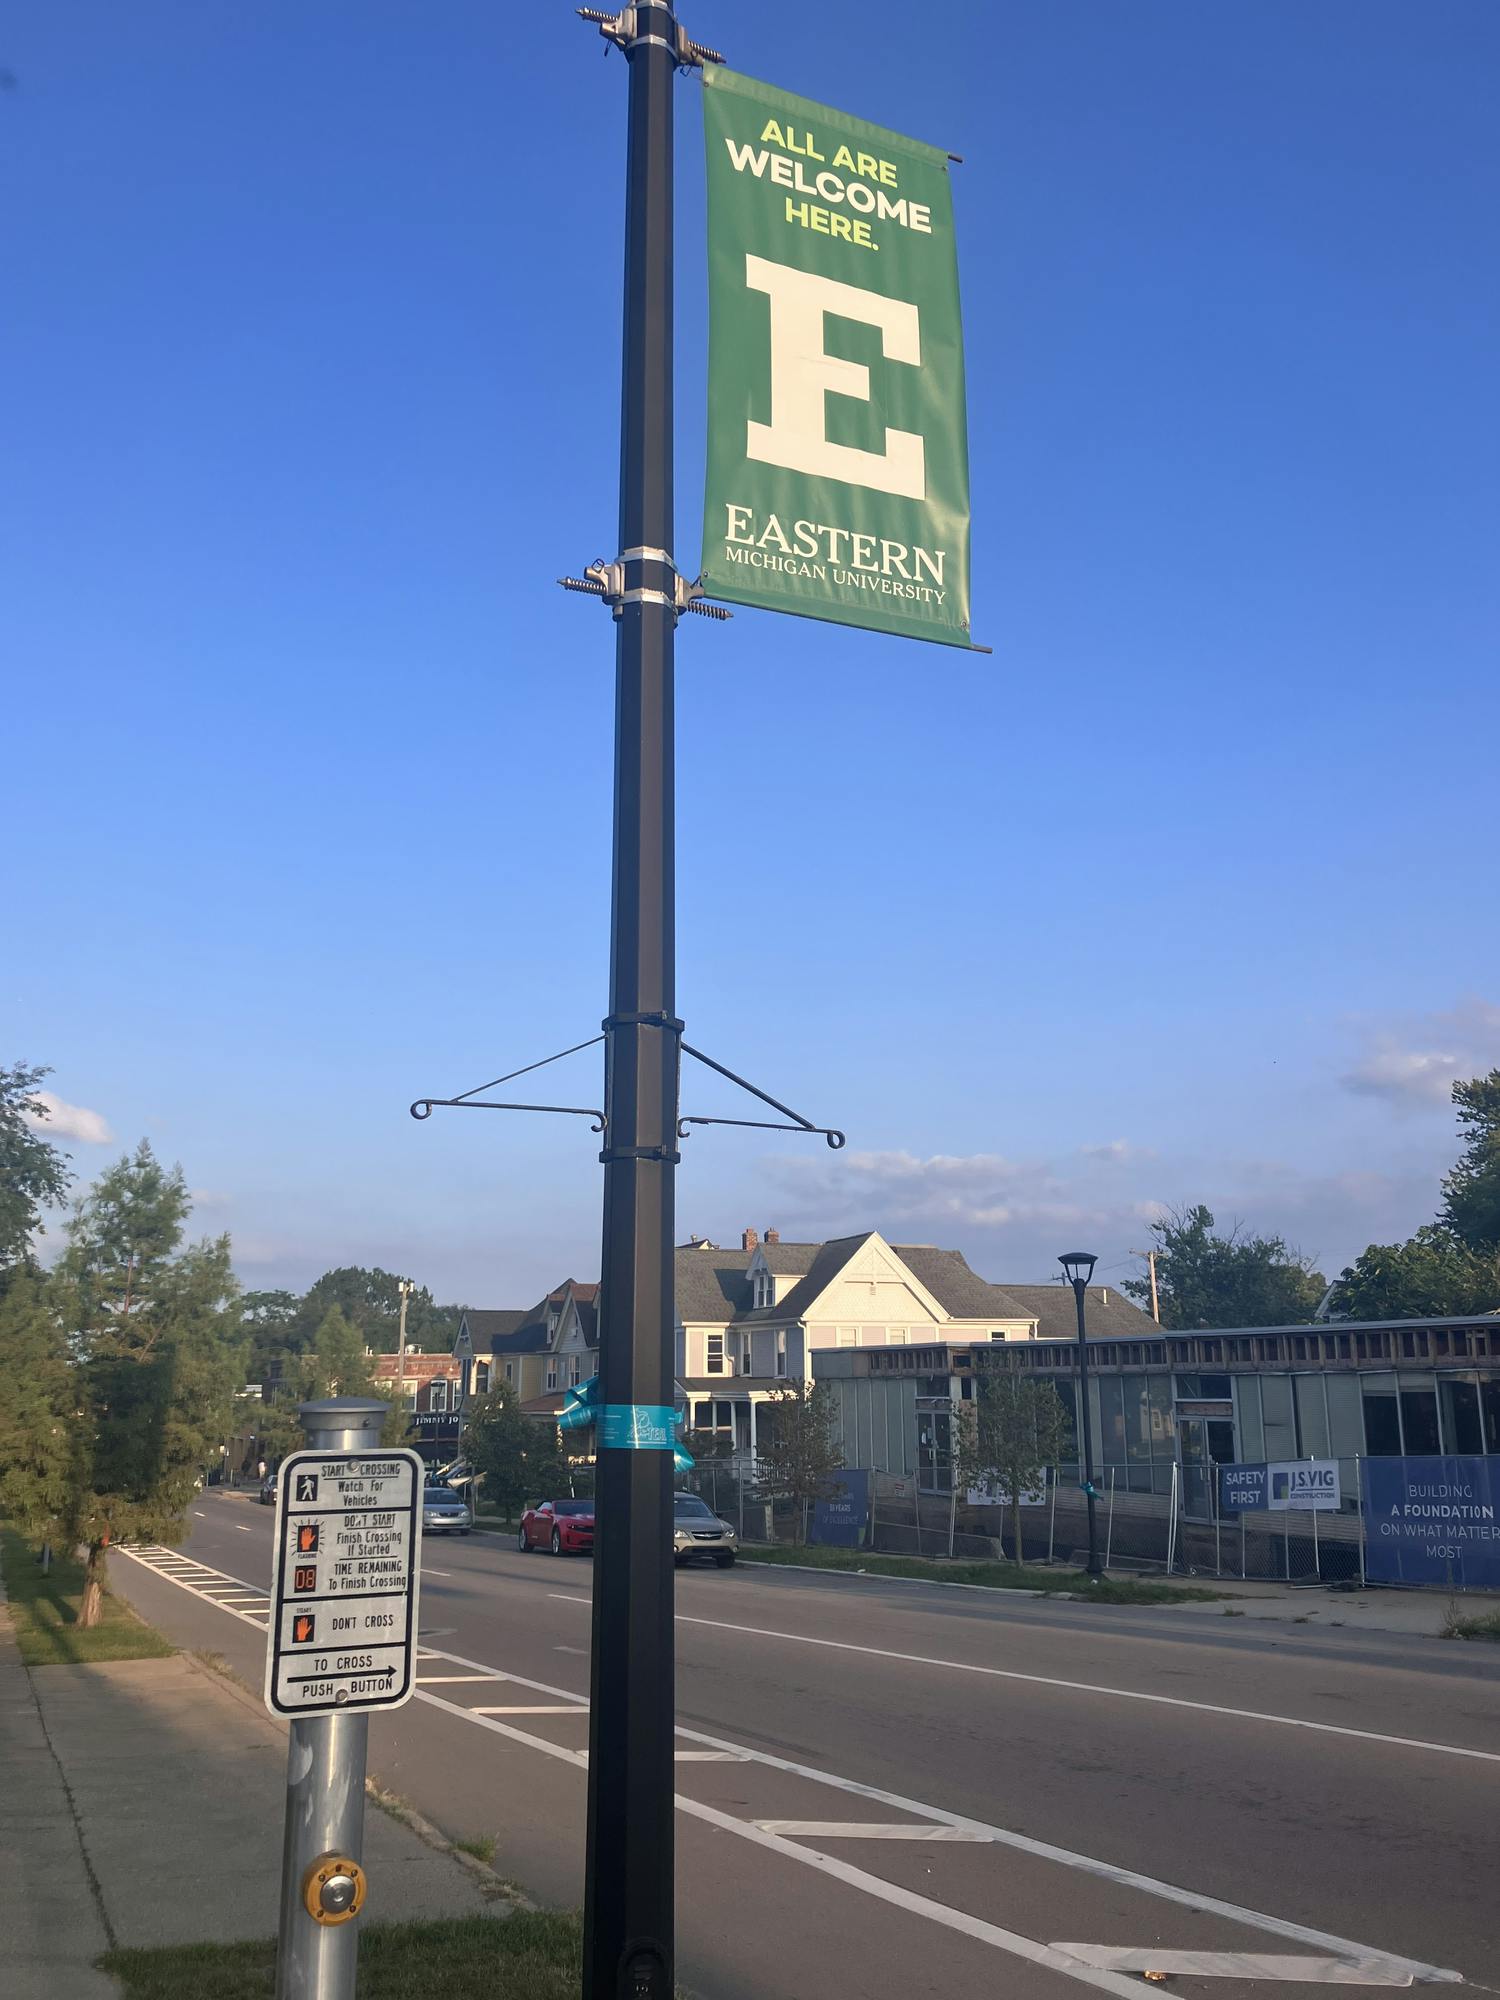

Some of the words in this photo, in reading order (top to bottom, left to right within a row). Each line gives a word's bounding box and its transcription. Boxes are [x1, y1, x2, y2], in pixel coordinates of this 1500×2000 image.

[760, 118, 826, 163] ALL
[832, 143, 898, 189] ARE
[725, 138, 933, 234] WELCOME
[785, 196, 880, 251] HERE.
[745, 253, 926, 501] E
[725, 503, 946, 587] EASTERN
[725, 545, 827, 579] MICHIGAN
[832, 568, 947, 605] UNIVERSITY
[321, 1464, 346, 1477] START
[360, 1463, 401, 1475] CROSSING
[1226, 1471, 1266, 1485] SAFETY
[338, 1480, 364, 1492] Watch
[370, 1480, 384, 1491] For
[1409, 1484, 1473, 1498] BUILDING
[343, 1495, 378, 1507] Vehicles
[1230, 1491, 1261, 1504] FIRST
[1391, 1504, 1401, 1516] A
[1404, 1504, 1494, 1518] FOUNDATION
[372, 1513, 396, 1526] START
[1380, 1523, 1400, 1536] ON
[1403, 1524, 1443, 1537] WHAT
[337, 1532, 362, 1544] Finish
[366, 1531, 402, 1544] Crossing
[348, 1545, 355, 1556] If
[358, 1543, 390, 1556] Started
[1426, 1545, 1463, 1559] MOST
[334, 1563, 352, 1575] TIME
[358, 1560, 402, 1574] REMAINING
[295, 1569, 316, 1588] 08
[328, 1578, 338, 1590] To
[341, 1577, 366, 1589] Finish
[370, 1575, 407, 1589] Crossing
[332, 1617, 357, 1630] DON'T
[365, 1614, 394, 1628] CROSS
[314, 1659, 328, 1671] TO
[337, 1655, 373, 1669] CROSS
[302, 1683, 334, 1698] PUSH
[350, 1678, 393, 1693] BUTTON
